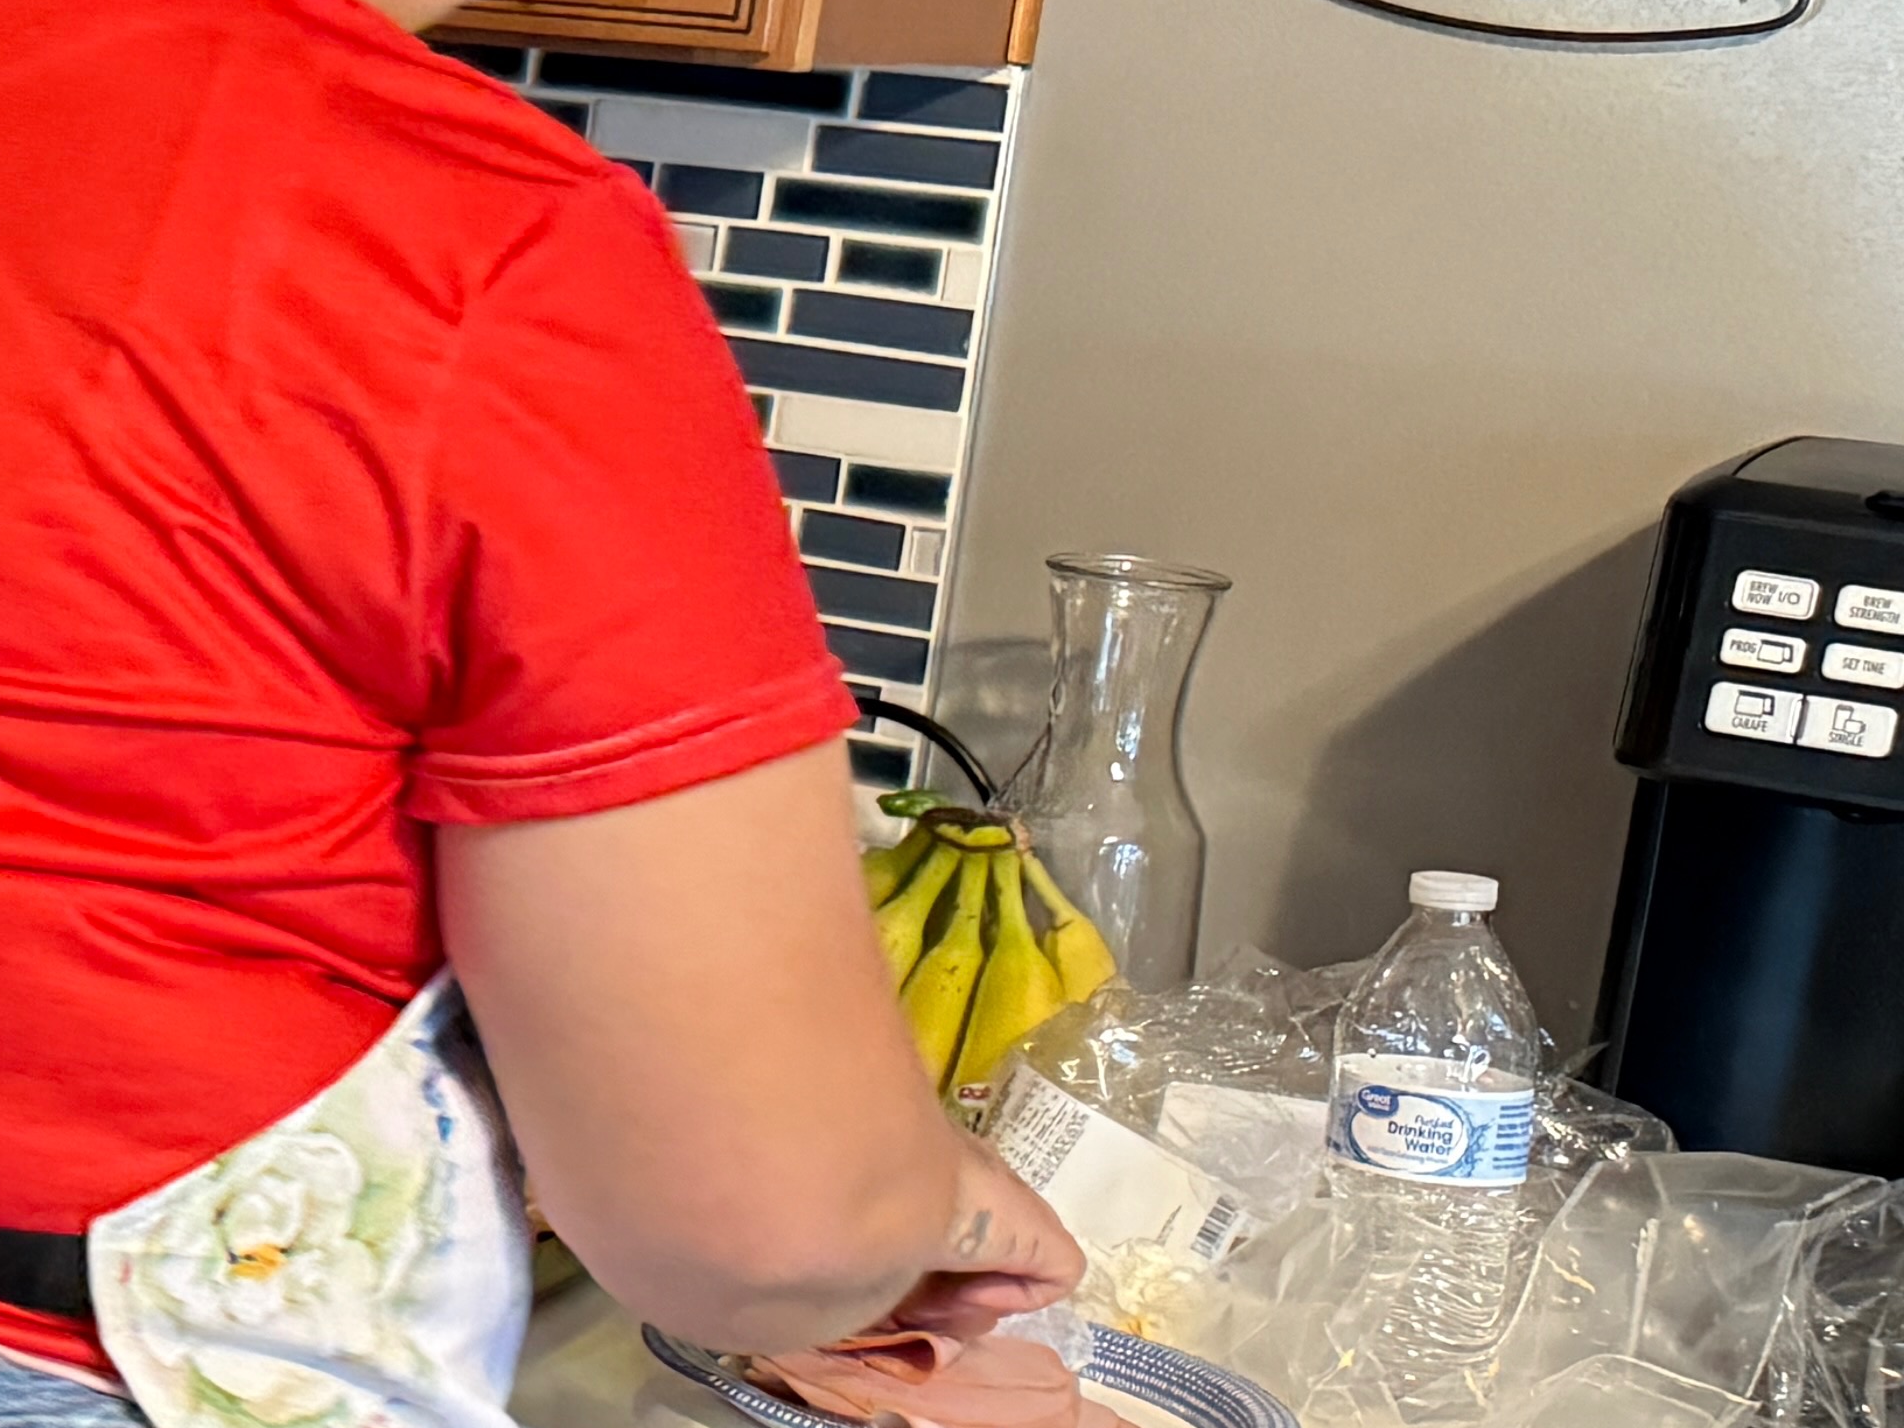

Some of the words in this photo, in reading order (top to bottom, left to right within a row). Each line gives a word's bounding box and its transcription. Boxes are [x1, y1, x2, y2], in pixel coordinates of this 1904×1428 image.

[1842, 657, 1861, 671] SET
[1862, 660, 1886, 675] TIME
[1732, 716, 1768, 733] CARAFE
[1828, 731, 1864, 747] SINGLE
[1361, 1089, 1392, 1106] Great
[1387, 1120, 1453, 1145] Drinking
[1404, 1138, 1452, 1155] Water
